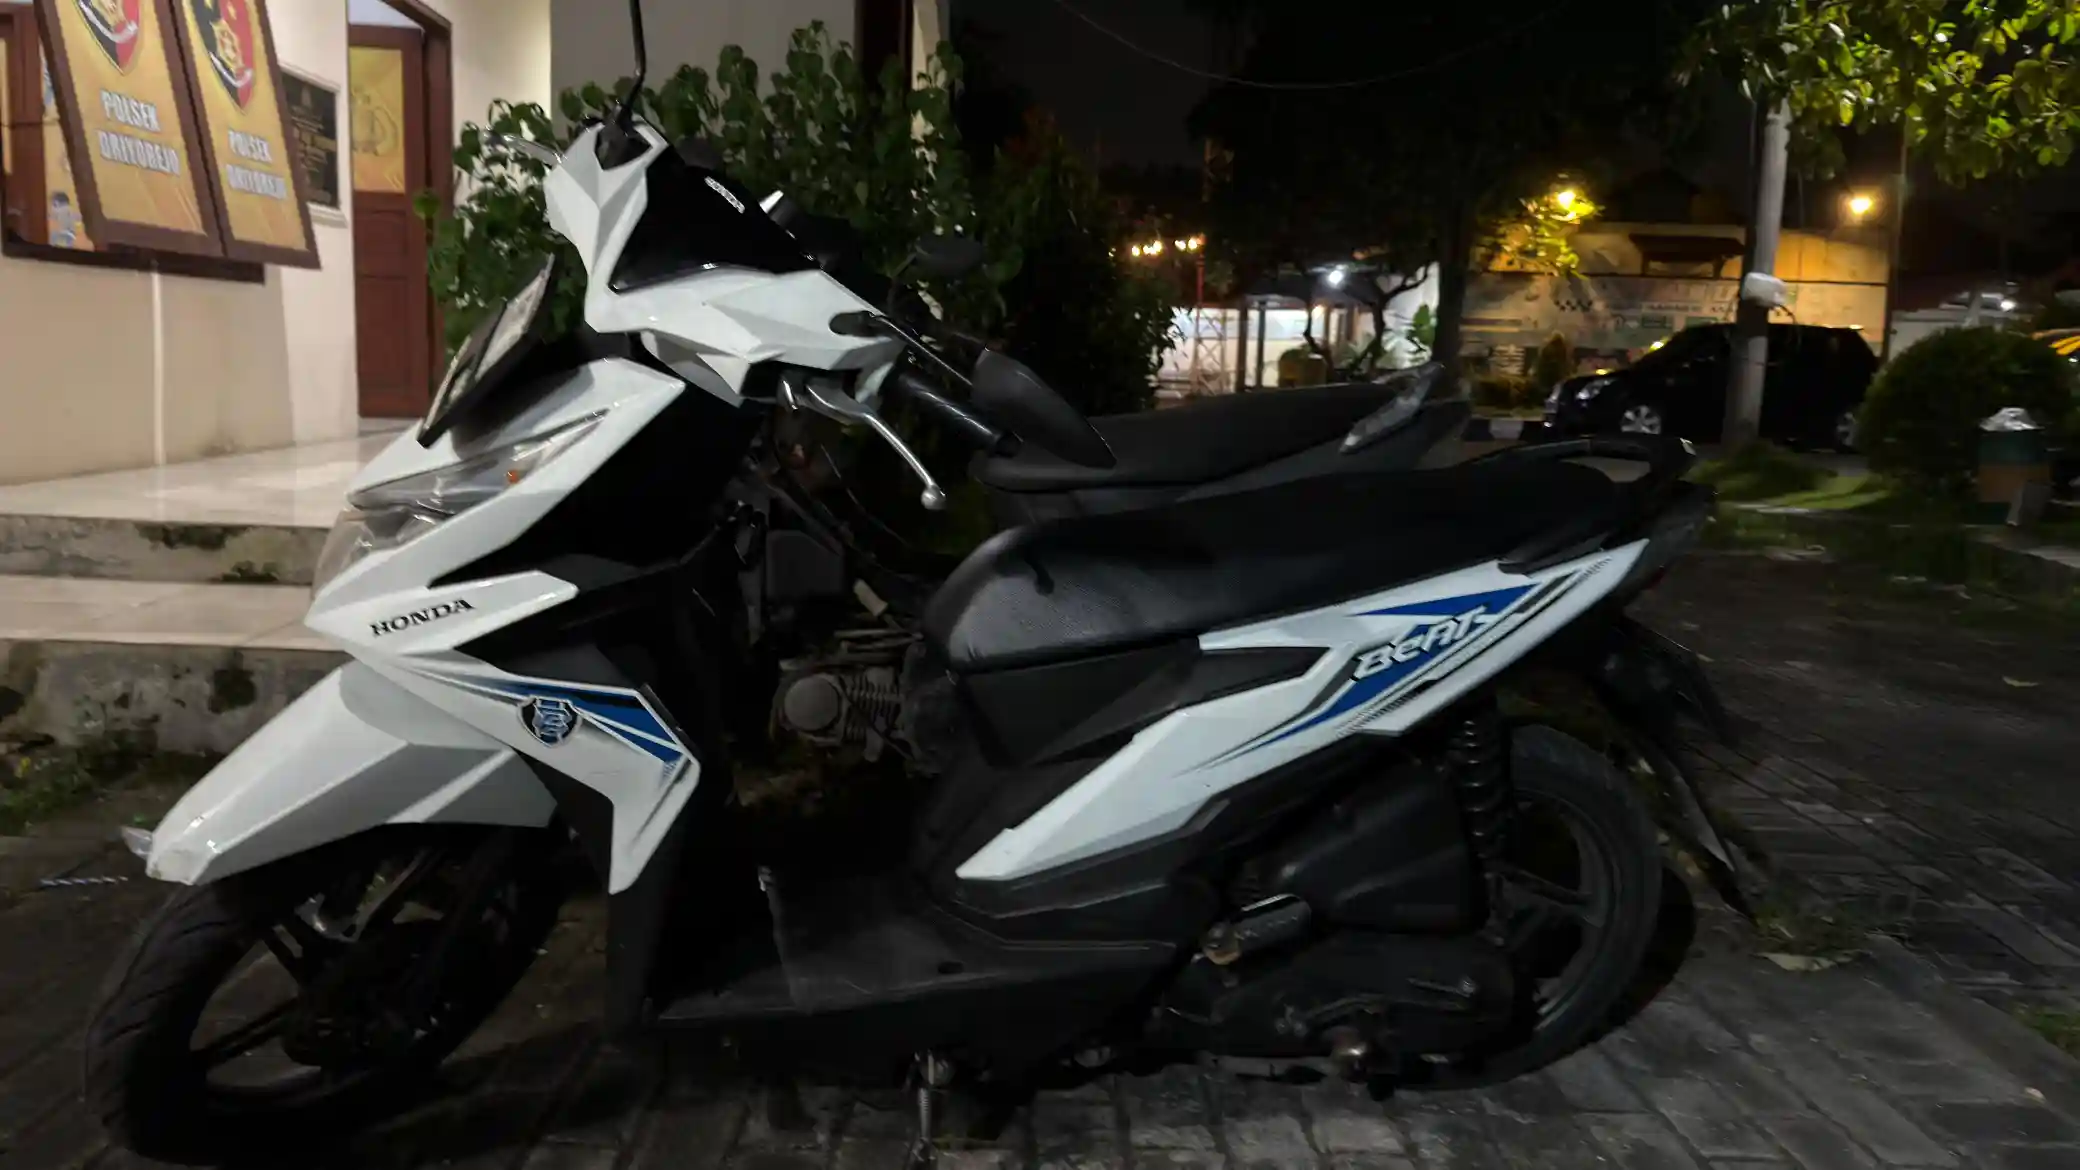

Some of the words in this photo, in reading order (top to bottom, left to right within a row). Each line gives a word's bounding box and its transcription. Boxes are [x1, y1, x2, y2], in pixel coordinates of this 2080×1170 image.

[101, 89, 160, 133] POLSEK
[228, 129, 273, 163] POLSEK
[369, 599, 475, 637] HONDA
